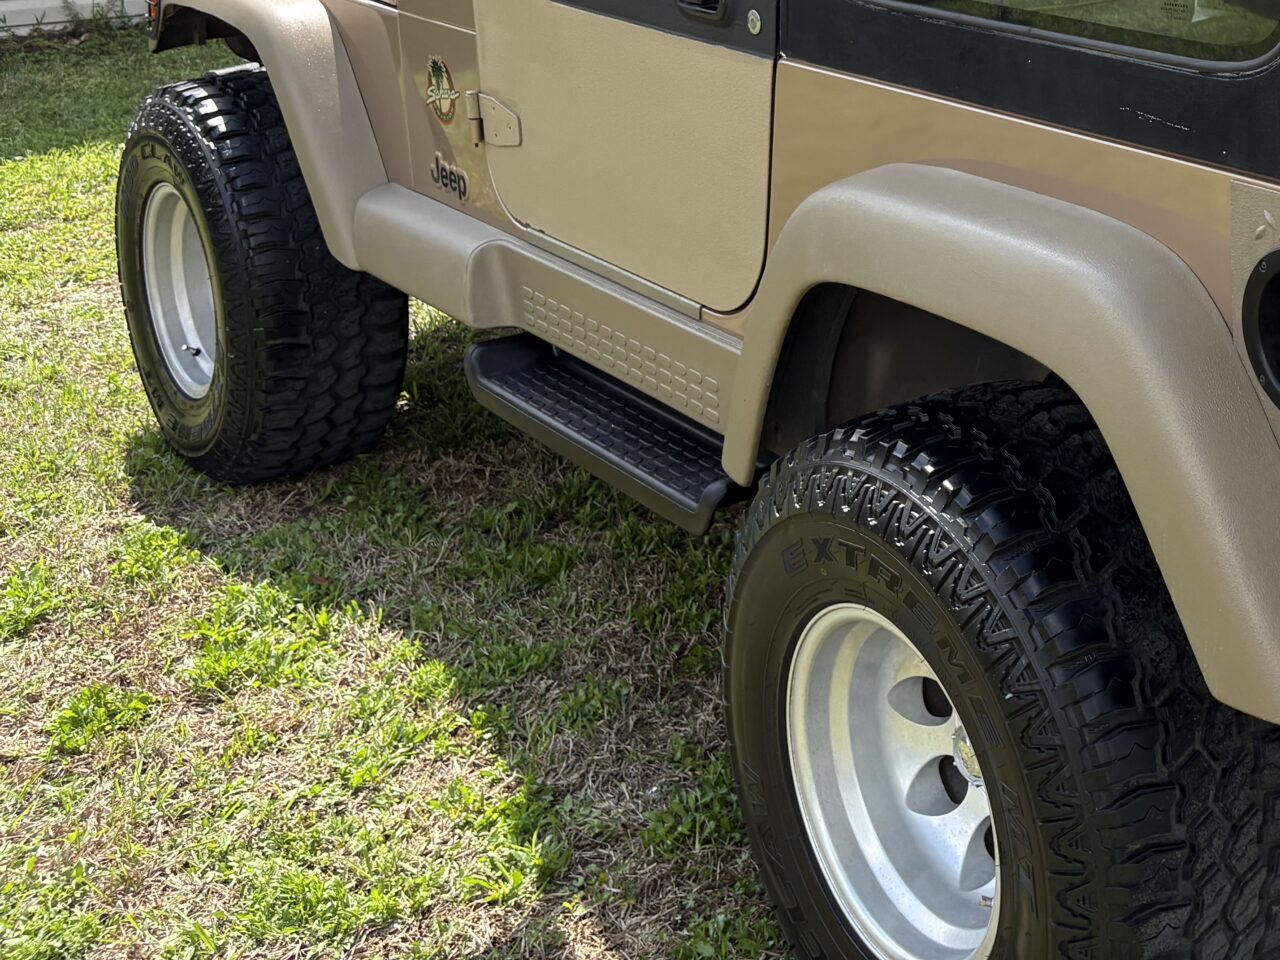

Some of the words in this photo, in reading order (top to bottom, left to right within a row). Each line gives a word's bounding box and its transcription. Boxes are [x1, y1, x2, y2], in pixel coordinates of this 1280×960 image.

[426, 85, 460, 105] Sahara
[430, 152, 469, 201] Jeep
[781, 536, 1005, 751] EXTREME
